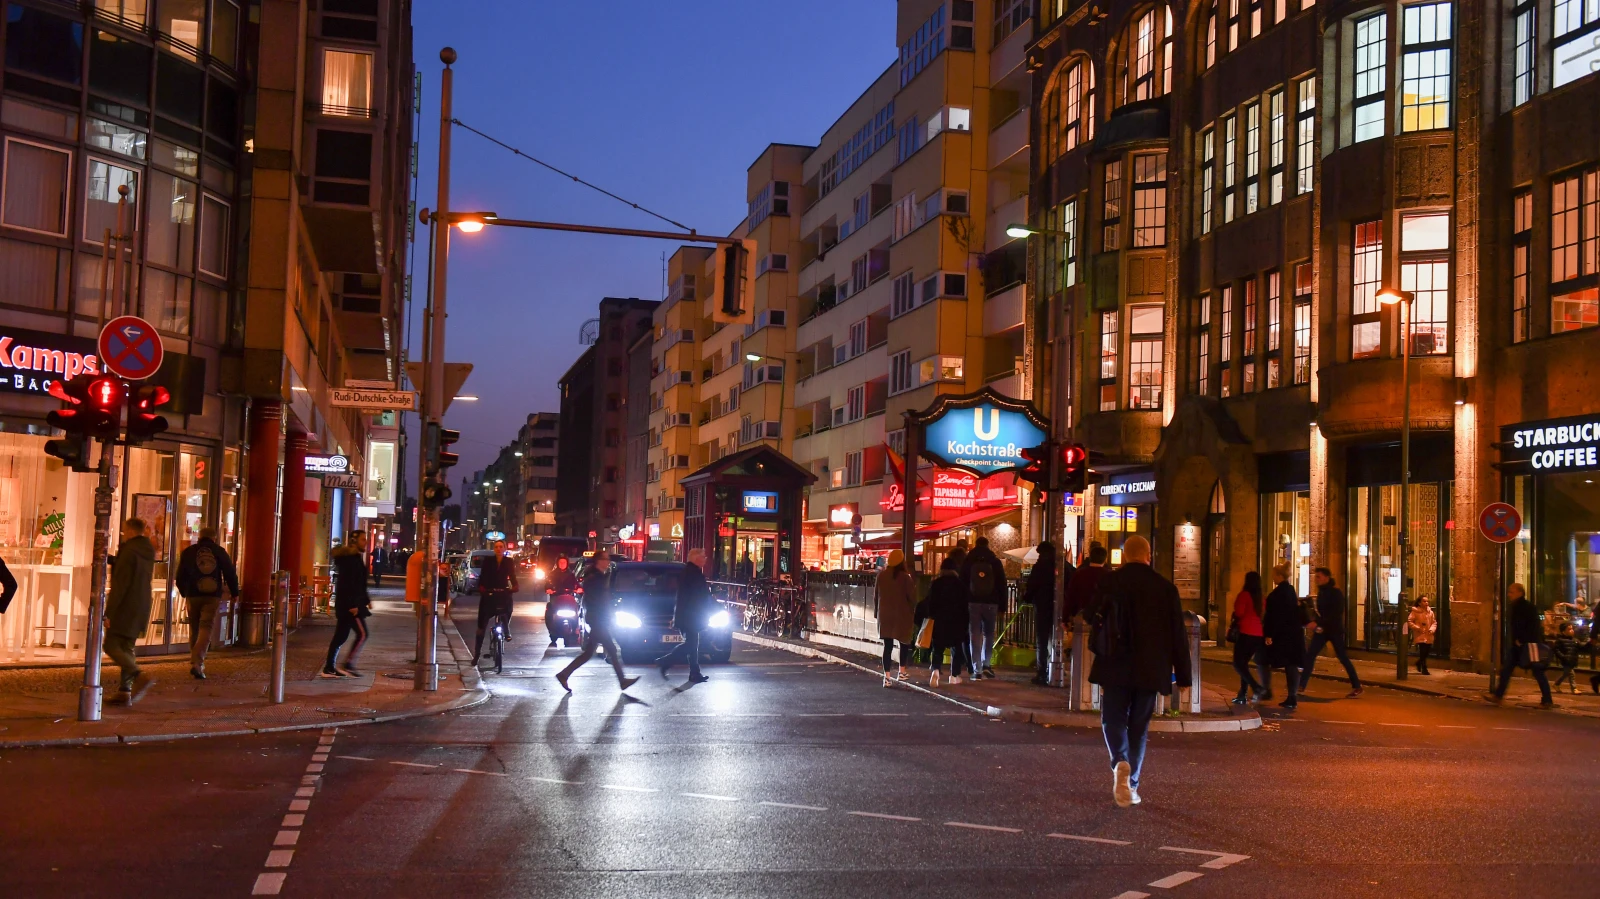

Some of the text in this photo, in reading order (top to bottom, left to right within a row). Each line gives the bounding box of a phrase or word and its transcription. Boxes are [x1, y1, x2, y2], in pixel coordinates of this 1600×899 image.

[334, 391, 411, 406] Rudi-Dutschke-Straße
[973, 407, 1000, 441] U
[947, 440, 1023, 458] Kochstraße
[955, 457, 1016, 468] Checkpoint Charlie
[1531, 447, 1597, 469] COFFEE
[933, 487, 967, 498] TAPASBAR
[968, 488, 975, 498] &
[1100, 483, 1127, 496] CURRENCY
[933, 497, 975, 508] RESTAURANT
[1065, 505, 1083, 514] ASH
